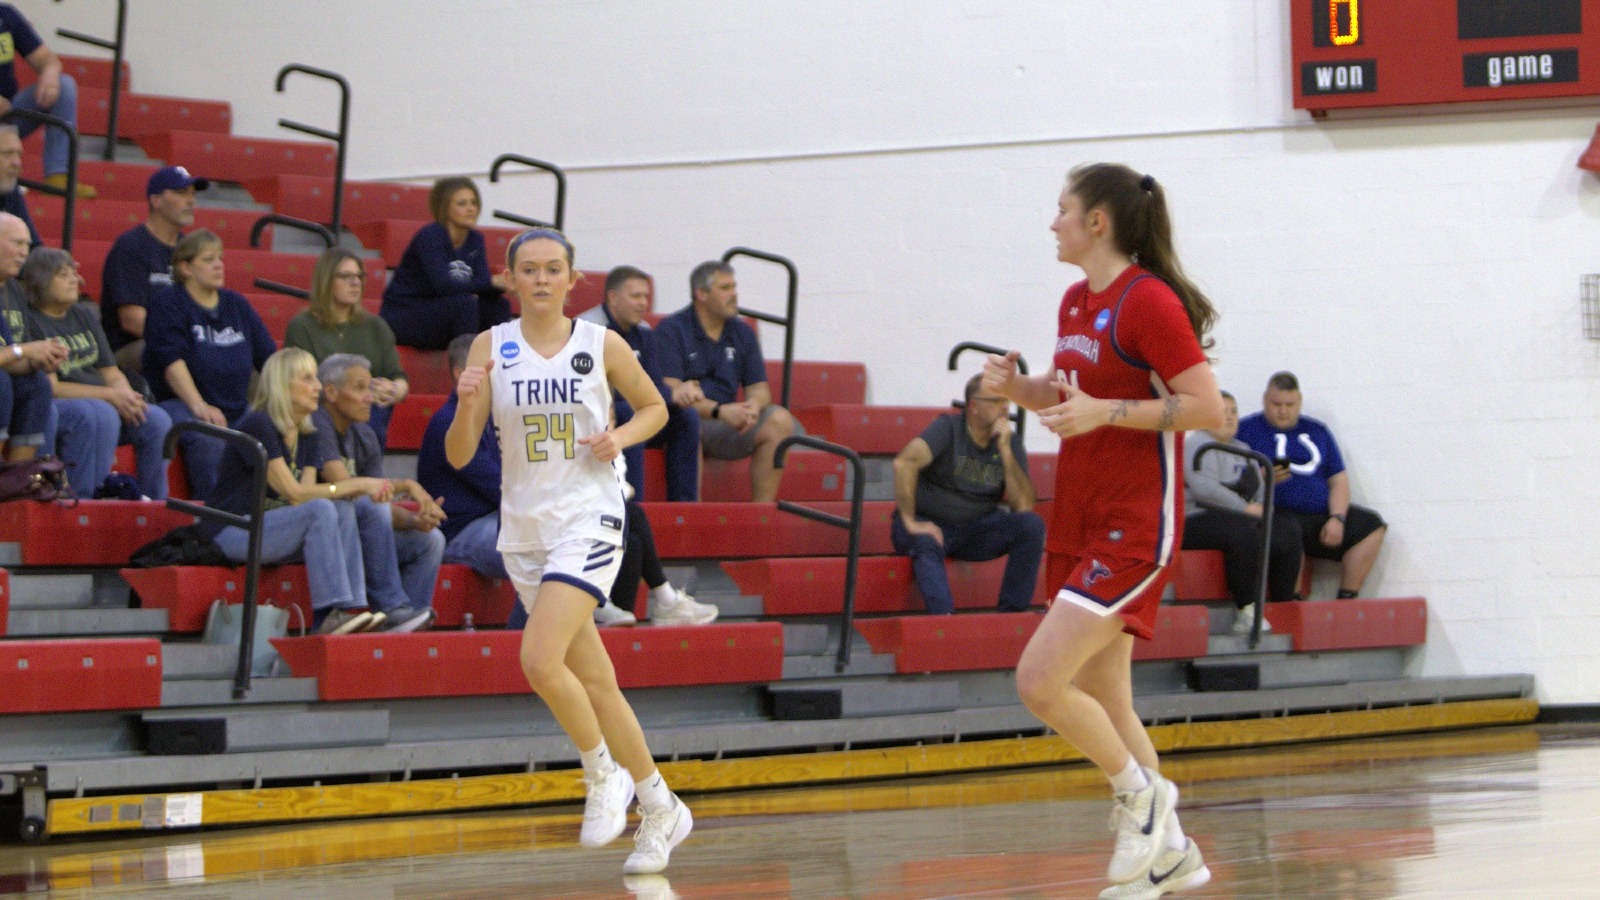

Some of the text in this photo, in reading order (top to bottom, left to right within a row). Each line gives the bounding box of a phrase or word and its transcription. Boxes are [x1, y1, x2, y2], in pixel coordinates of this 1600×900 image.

[1315, 64, 1364, 91] won
[1487, 53, 1554, 87] game
[511, 378, 584, 407] TRINE
[522, 412, 576, 463] 24
